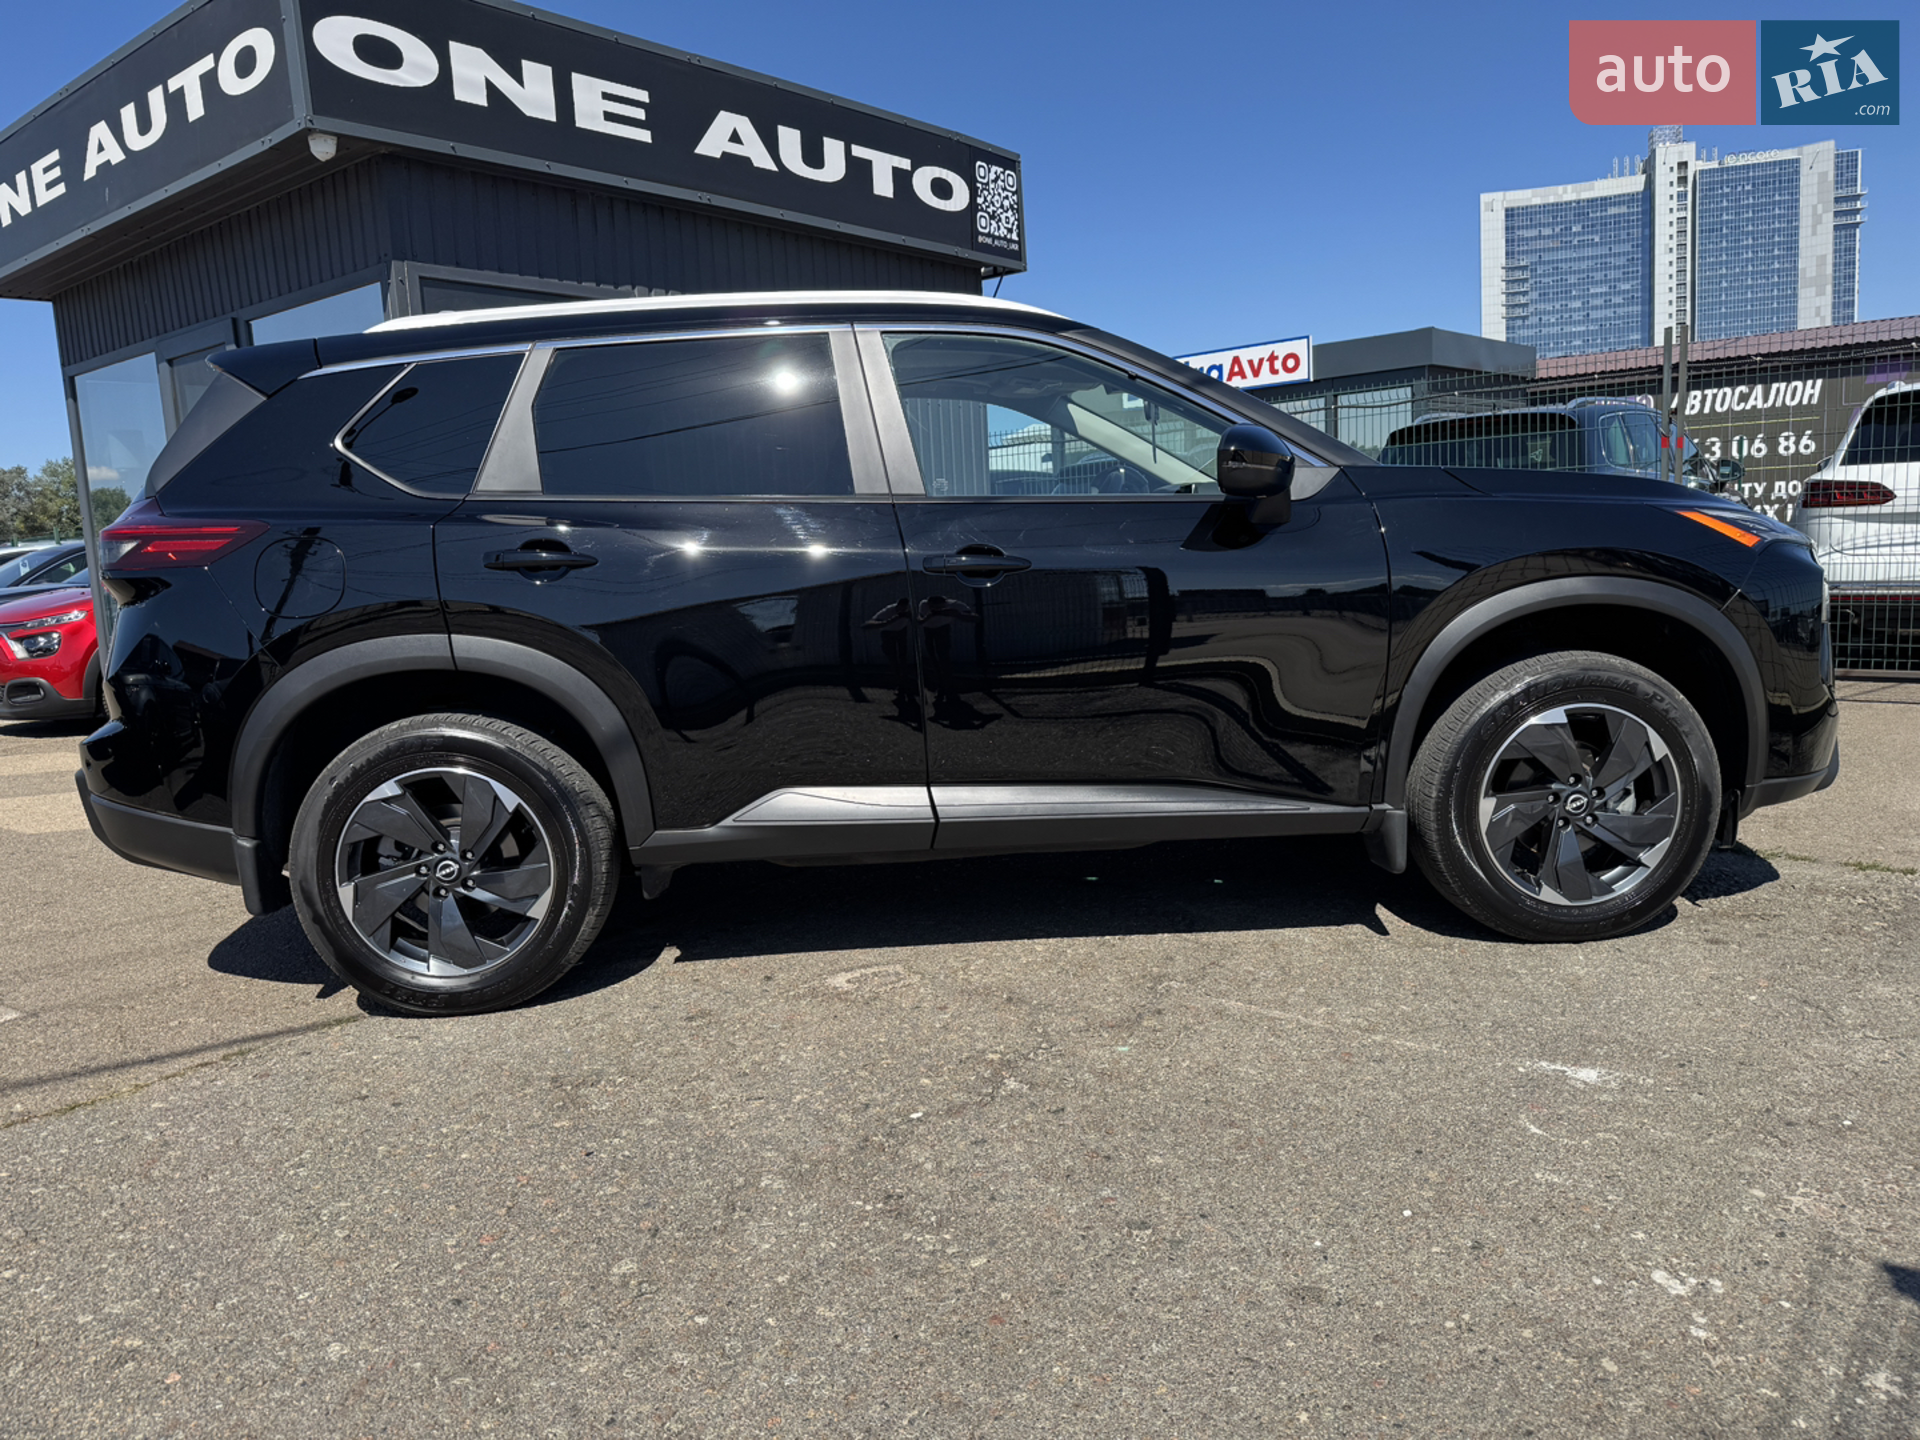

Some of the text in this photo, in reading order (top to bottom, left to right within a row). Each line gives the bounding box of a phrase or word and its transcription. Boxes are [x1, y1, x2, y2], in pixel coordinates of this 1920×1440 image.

[83, 27, 276, 182] AUTO
[312, 15, 971, 212] ONE AUTO
[1727, 148, 1780, 164] encore
[1184, 350, 1301, 383] gAvto
[1694, 430, 1816, 461] 3 06 86
[1734, 481, 1767, 499] ТУ
